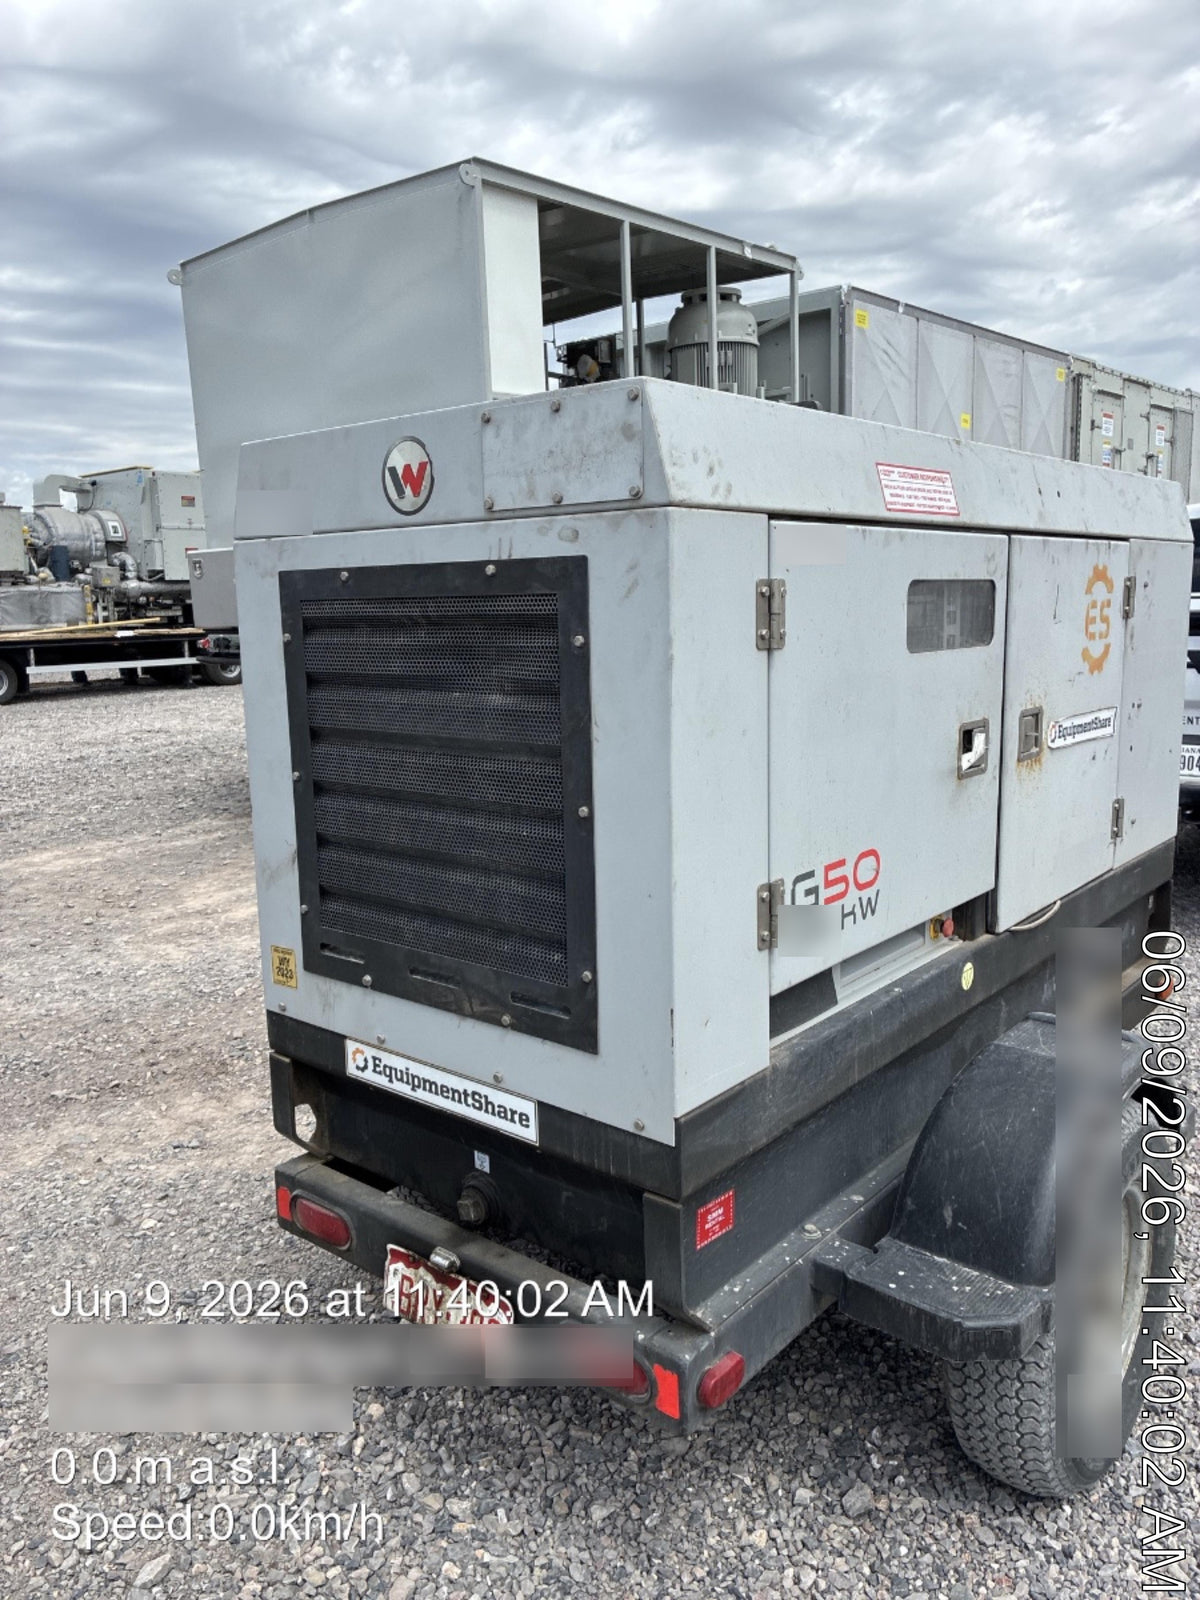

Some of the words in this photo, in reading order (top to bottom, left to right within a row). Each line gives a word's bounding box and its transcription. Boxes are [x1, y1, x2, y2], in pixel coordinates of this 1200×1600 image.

[1085, 598, 1112, 641] ES
[1057, 715, 1112, 741] EquipmentShare
[791, 848, 881, 906] G50
[371, 1055, 531, 1130] EquipmentShare
